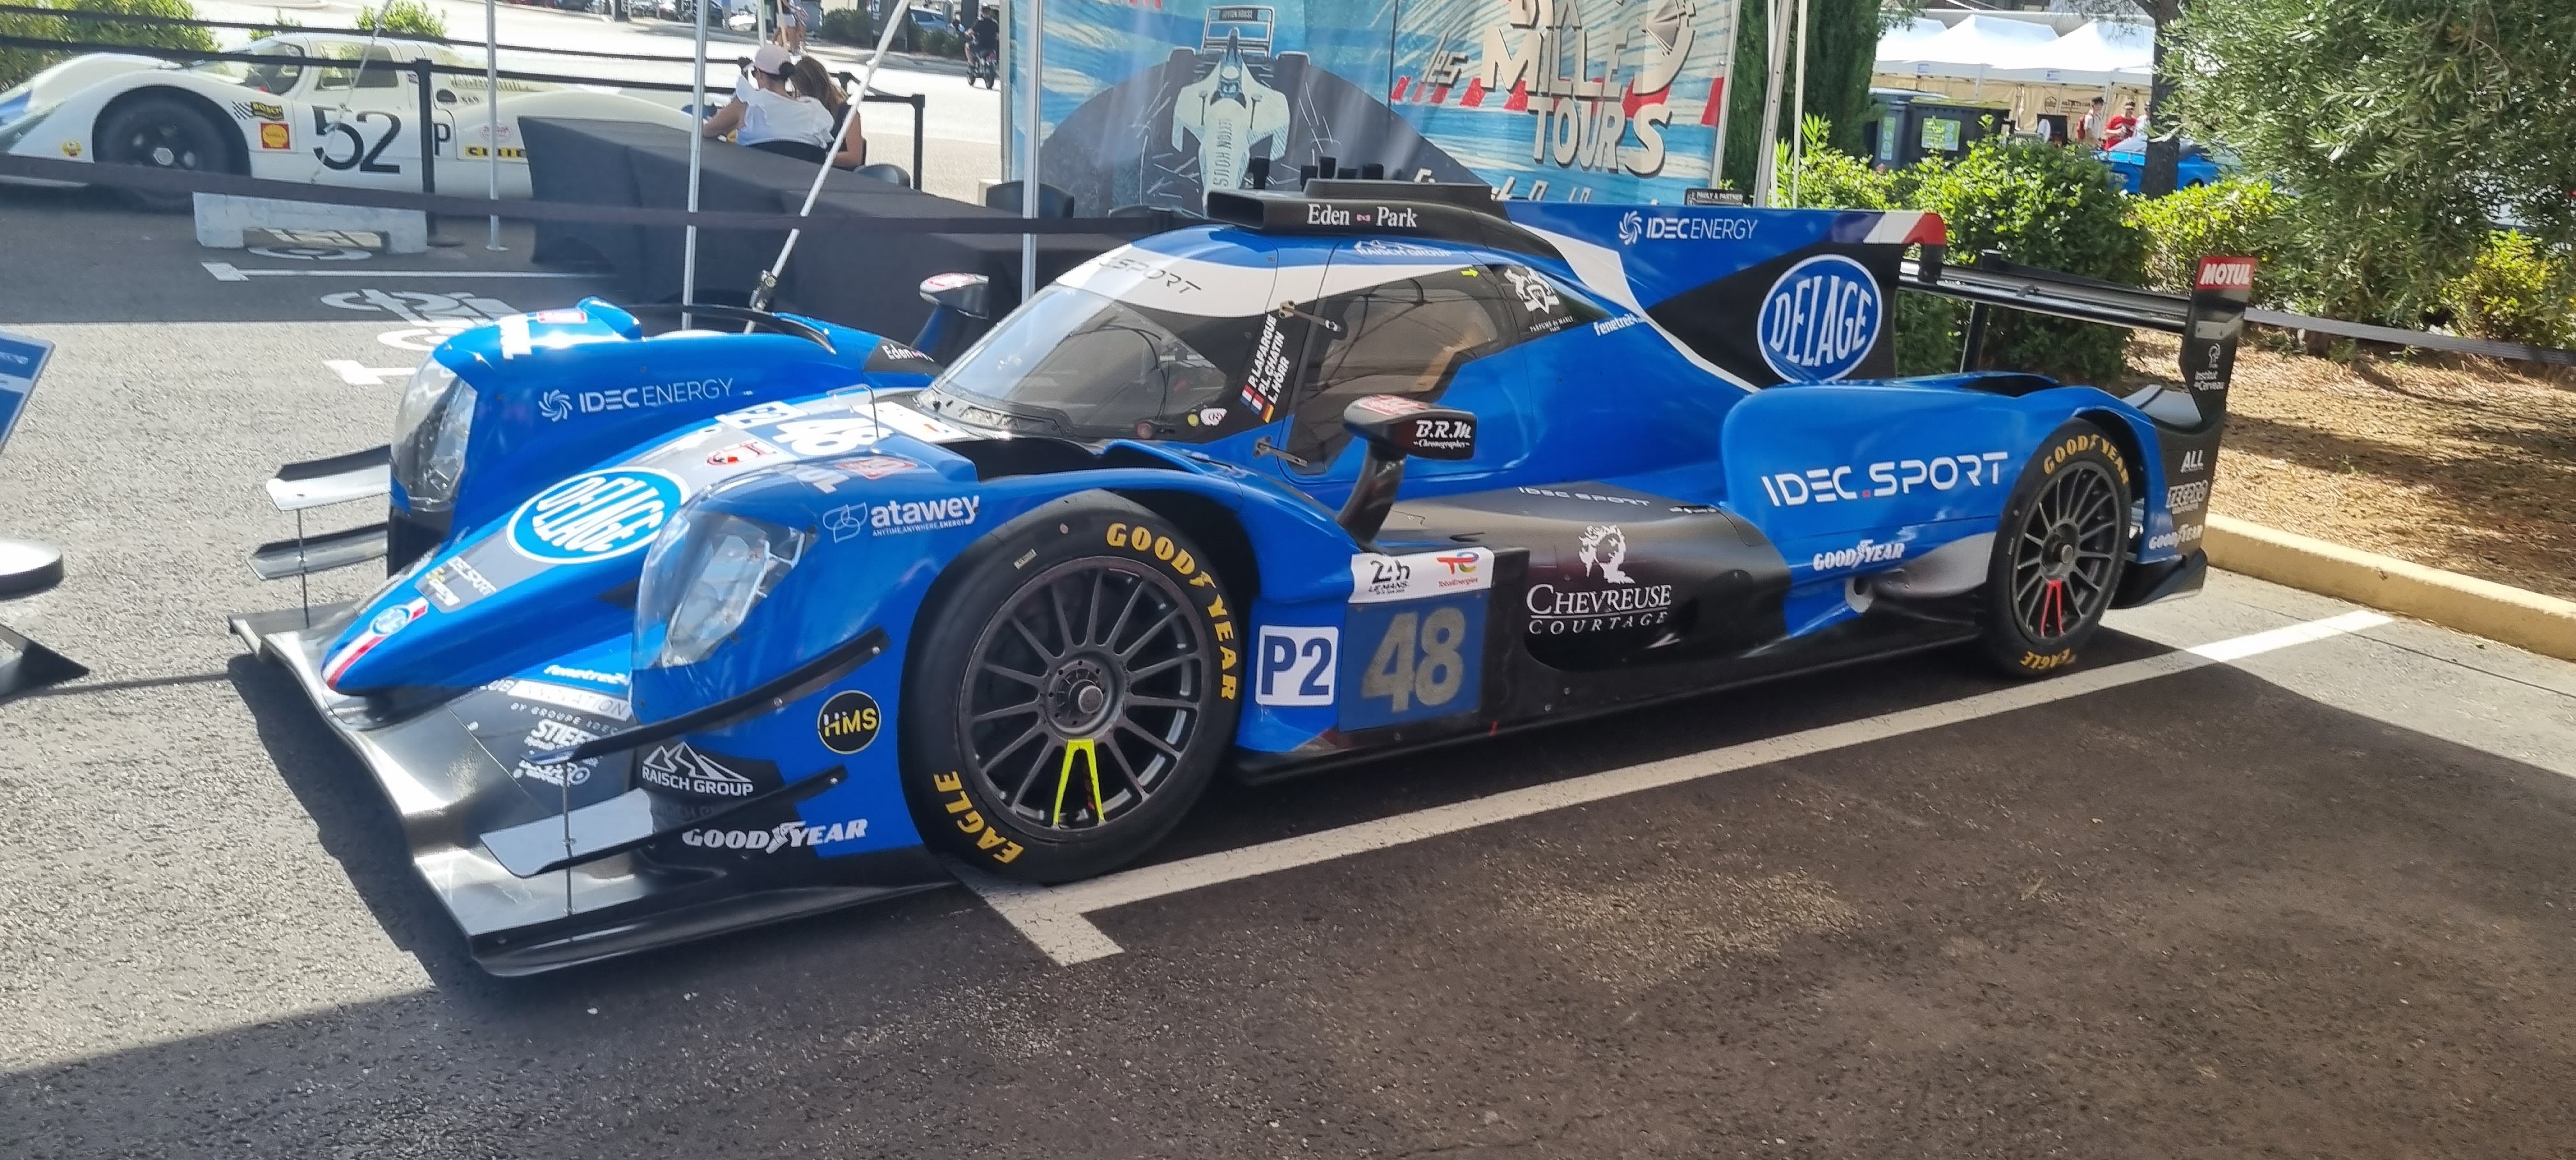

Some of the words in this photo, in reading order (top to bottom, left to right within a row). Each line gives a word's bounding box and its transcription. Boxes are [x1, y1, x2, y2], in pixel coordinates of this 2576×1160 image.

[312, 105, 401, 174] 52
[1528, 96, 1673, 178] TOURS
[1213, 151, 1232, 188] HOUS
[1307, 203, 1351, 227] Eden
[1375, 205, 1418, 229] Park
[2199, 263, 2251, 287] MOTUL
[1768, 275, 1873, 367] DELAGE
[1251, 313, 1277, 379] LAFARGUE
[1264, 330, 1285, 377] CHATIN
[1271, 355, 1290, 394] HÖRR
[579, 388, 640, 414] IDEC
[643, 378, 733, 406] ENERGY
[532, 475, 666, 553] DELAGE
[870, 494, 980, 530] atawey
[1574, 492, 1650, 507] SPORT
[1813, 538, 1905, 571] GOODYEAR
[1528, 611, 1670, 636] COURTAGE
[1261, 634, 1333, 697] P2
[1361, 606, 1467, 714] 48
[531, 705, 581, 725] GROUPE
[823, 707, 878, 738] HMS
[641, 766, 689, 791] RAISCH
[693, 779, 754, 797] GROUP
[933, 770, 1024, 864] EAGLE
[681, 818, 868, 853] GOODYEAR
